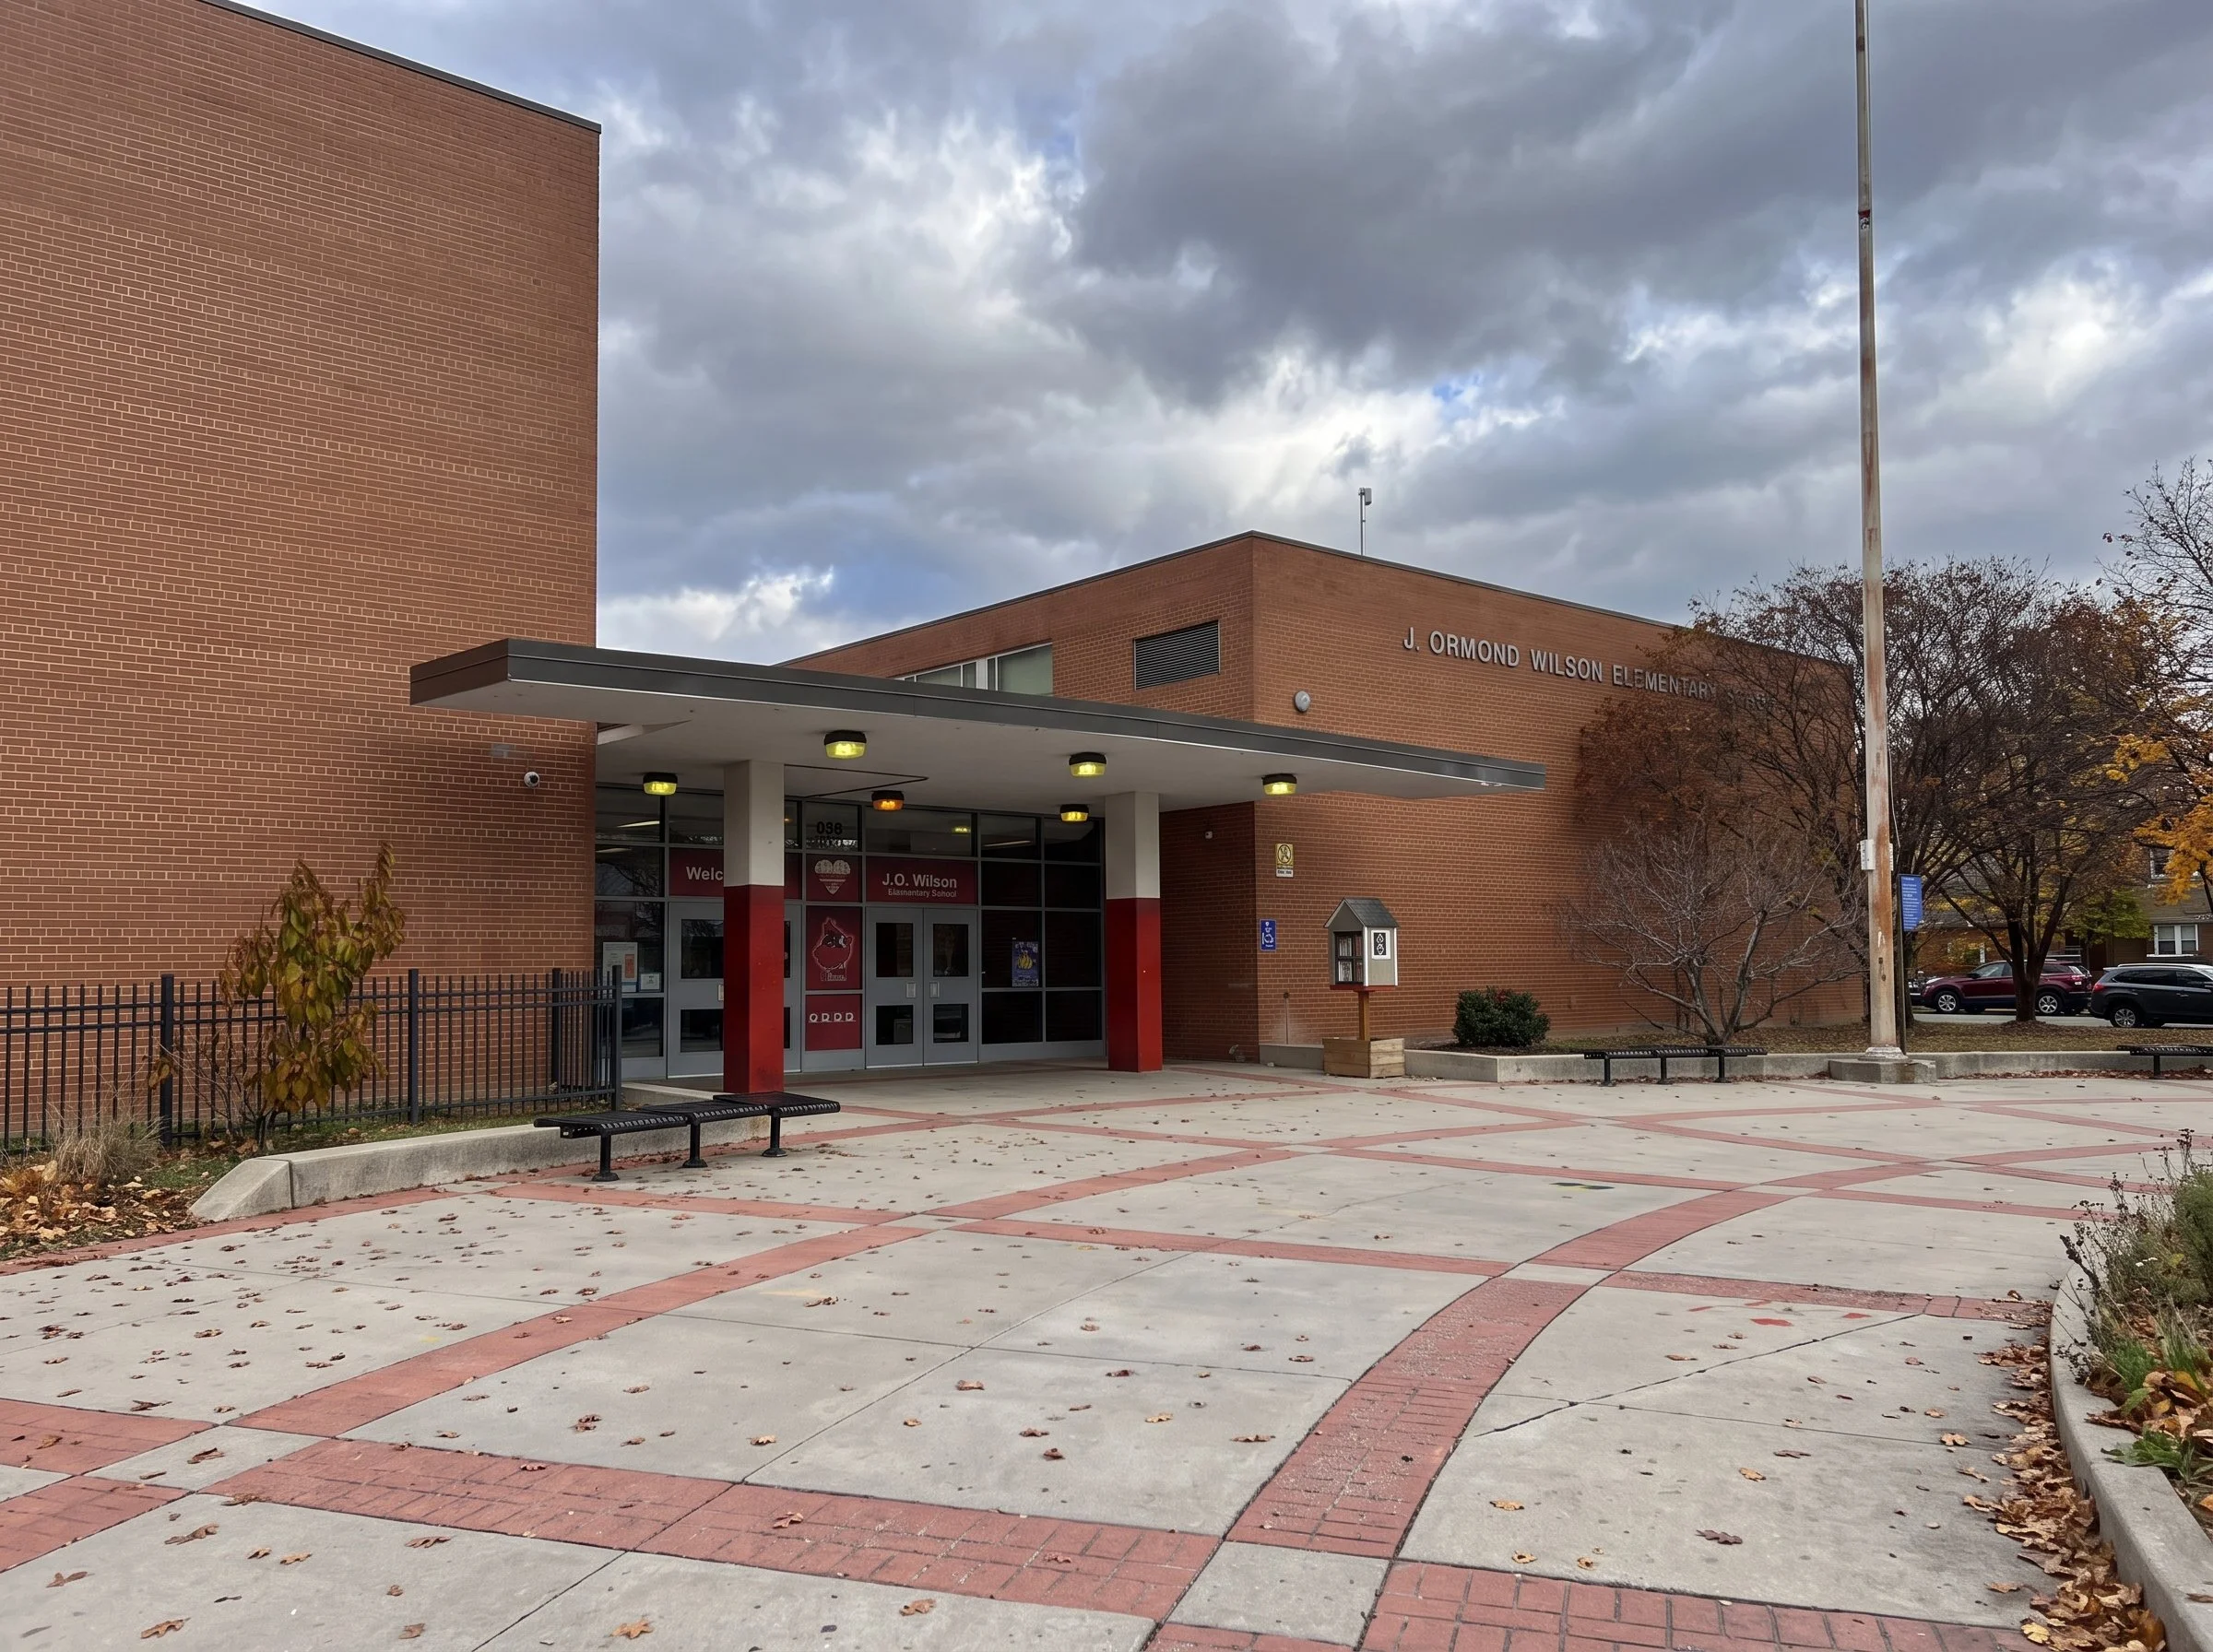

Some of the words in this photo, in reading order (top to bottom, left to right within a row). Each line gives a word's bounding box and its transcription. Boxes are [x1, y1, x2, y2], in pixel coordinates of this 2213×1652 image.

[1403, 627, 1420, 651] J.
[1429, 631, 1520, 667] ORMOND
[1530, 649, 1603, 682] WILSON
[686, 866, 724, 880] Welc
[882, 873, 909, 886] J.O.
[913, 874, 957, 888] Wilson
